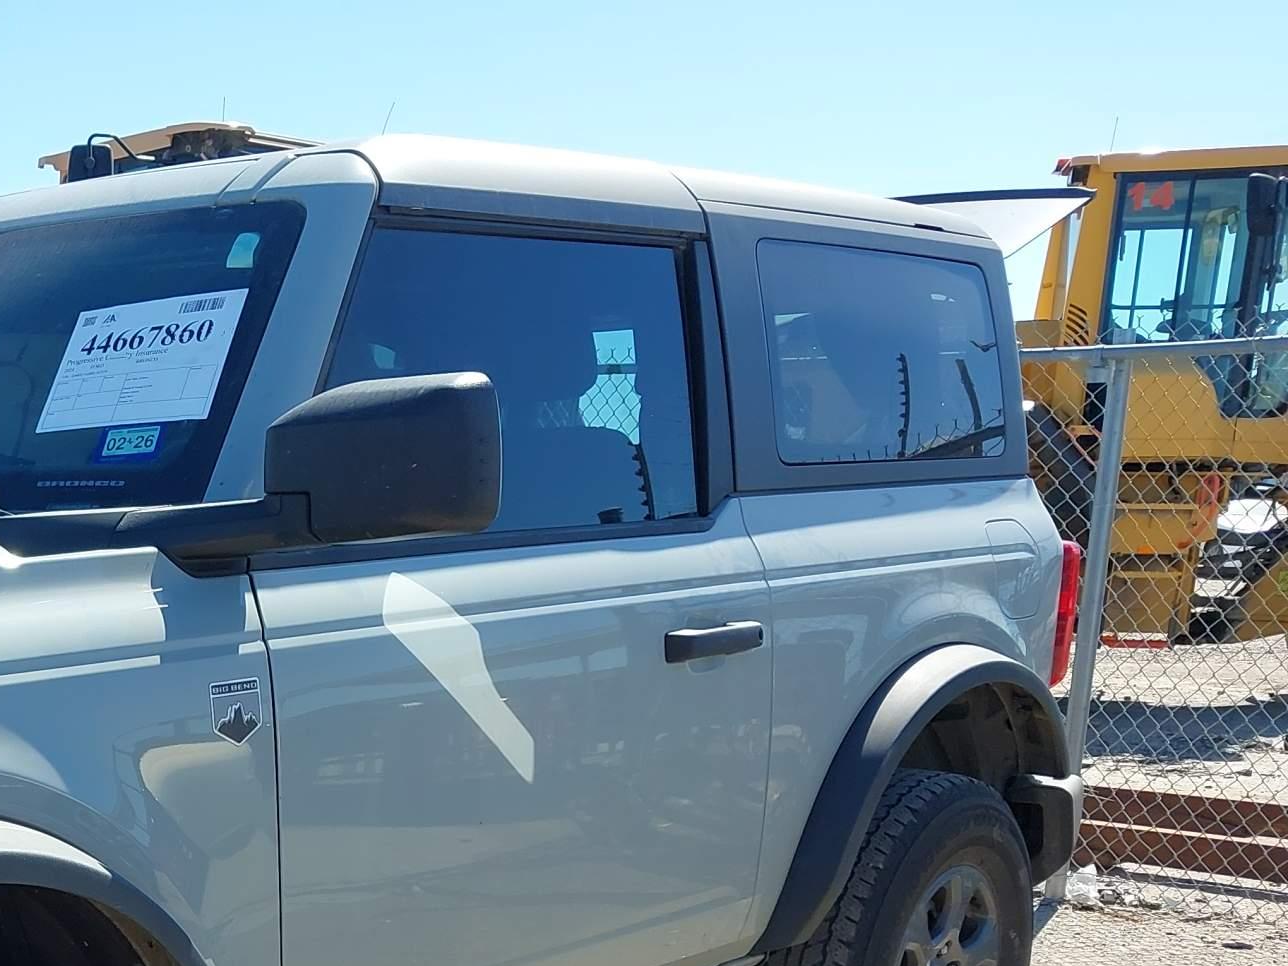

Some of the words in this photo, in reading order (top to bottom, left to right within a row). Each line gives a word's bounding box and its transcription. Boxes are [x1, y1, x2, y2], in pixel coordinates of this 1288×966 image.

[1128, 181, 1175, 211] 14
[81, 319, 214, 356] 44667860
[66, 355, 104, 367] Progressive
[135, 347, 169, 358] Insurance
[106, 436, 127, 451] 02
[133, 434, 155, 449] 26
[212, 685, 229, 694] BIG
[231, 682, 256, 691] BEND
